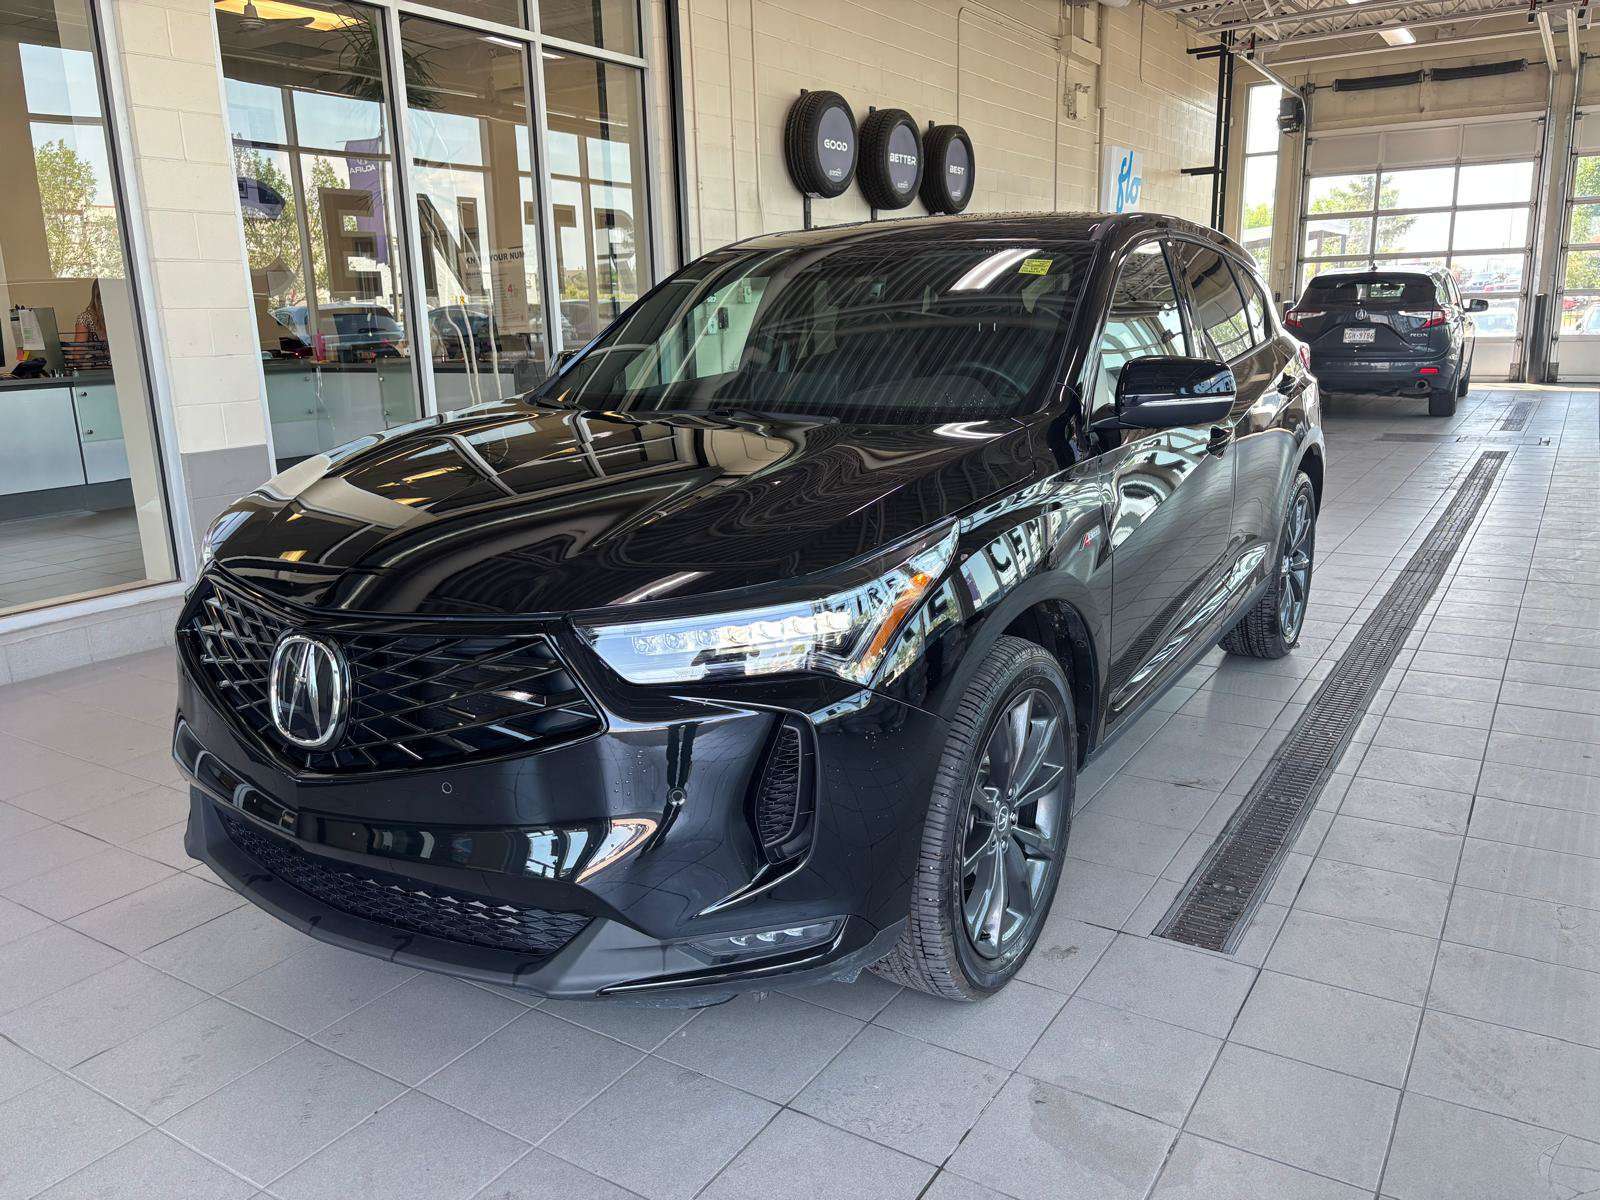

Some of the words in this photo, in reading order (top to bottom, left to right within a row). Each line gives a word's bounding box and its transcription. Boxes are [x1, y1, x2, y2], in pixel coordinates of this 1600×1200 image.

[823, 138, 848, 152] GOOD
[889, 152, 917, 166] BETTER
[949, 165, 966, 176] BEST
[1116, 150, 1142, 213] flo
[490, 252, 508, 262] YOUR
[510, 251, 525, 260] NUM
